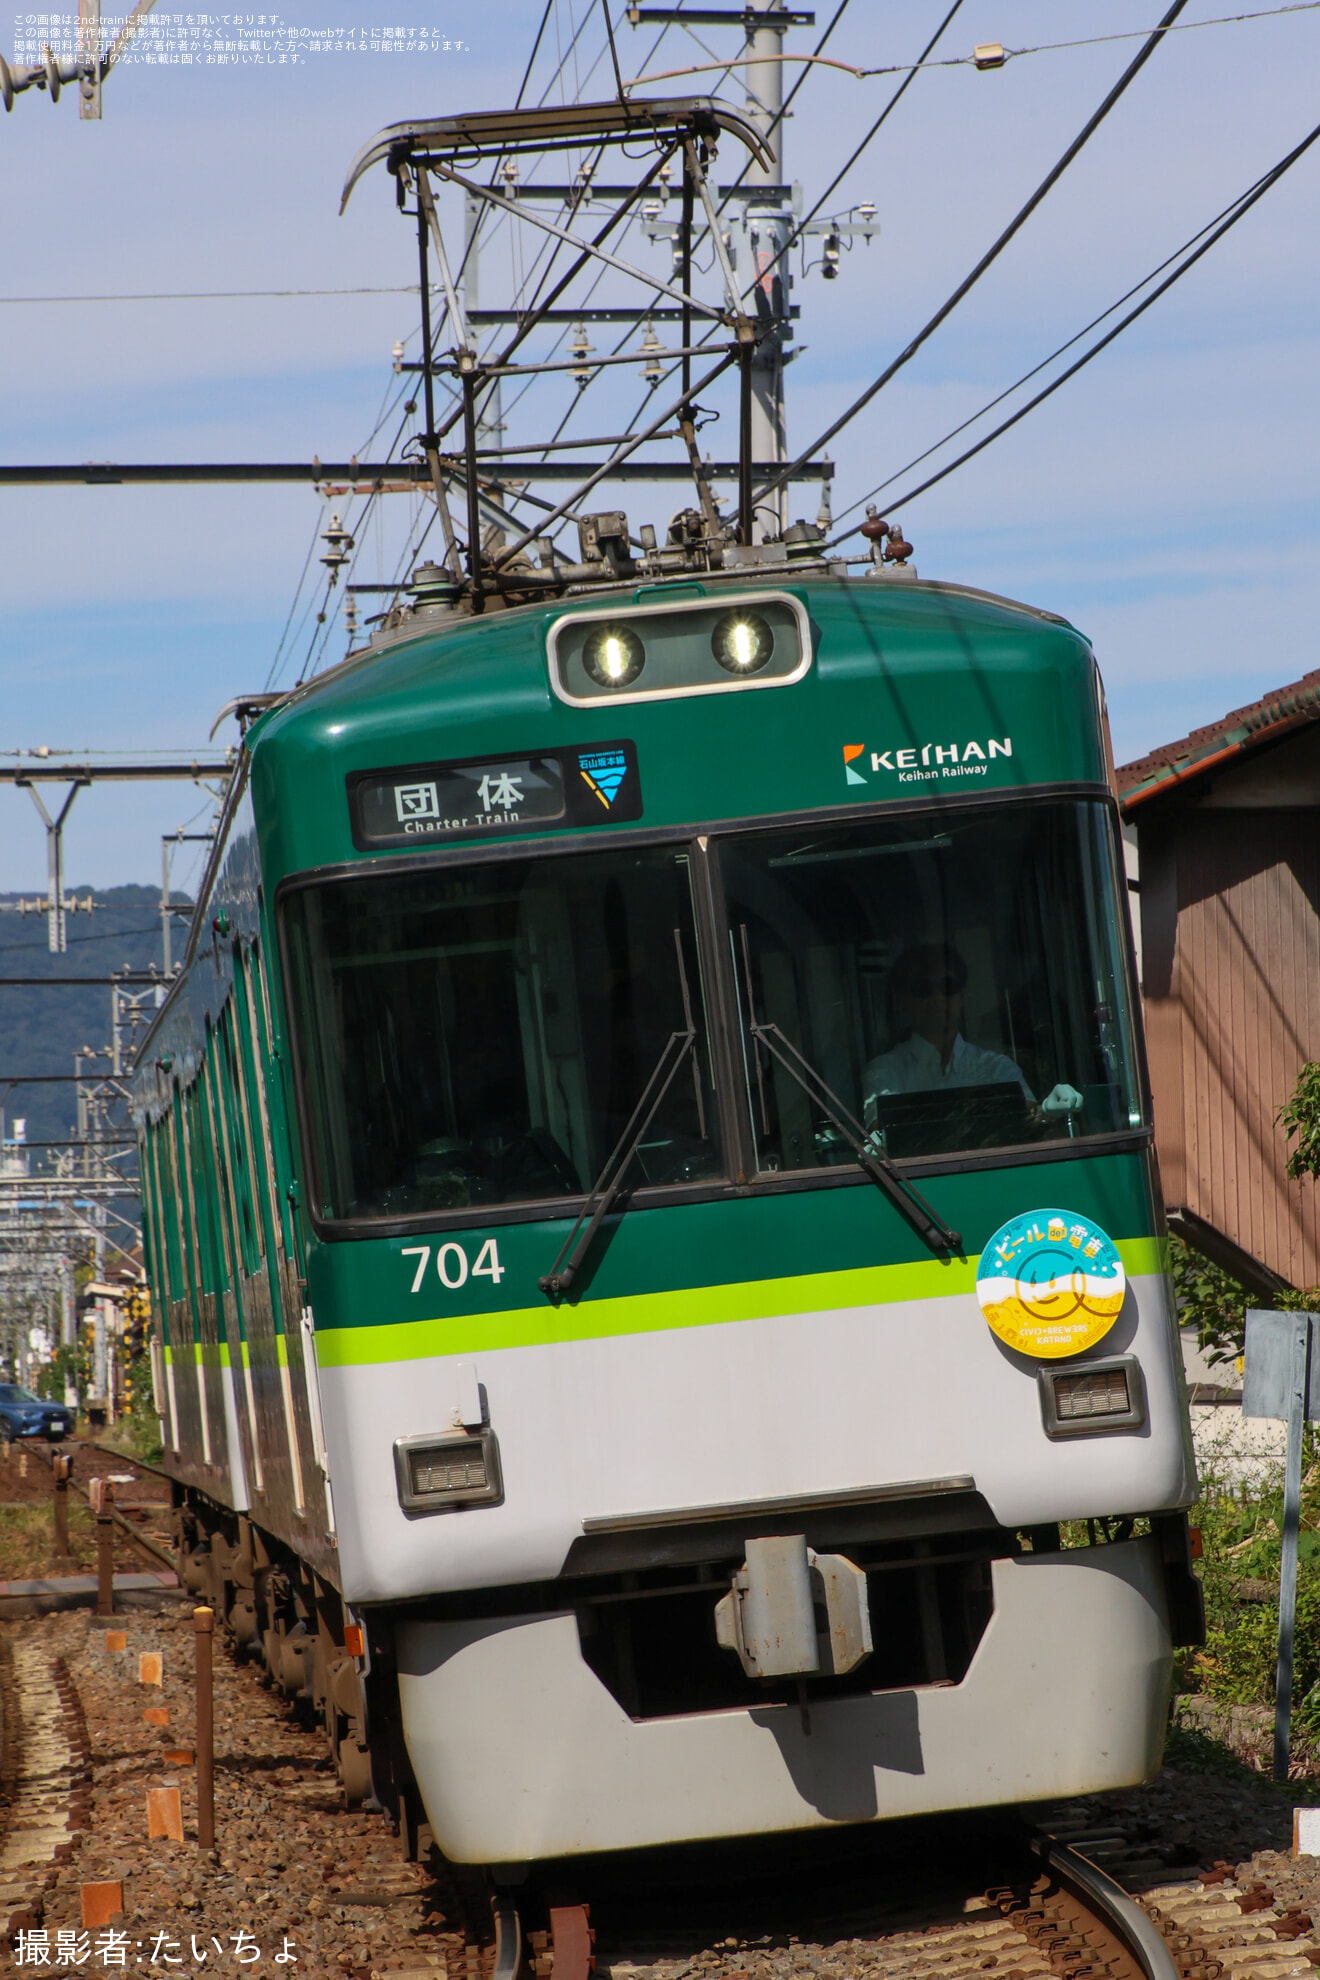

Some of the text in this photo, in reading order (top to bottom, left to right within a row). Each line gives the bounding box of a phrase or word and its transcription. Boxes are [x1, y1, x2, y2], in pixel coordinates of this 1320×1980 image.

[578, 755, 625, 770] 石山坂本線
[870, 737, 1013, 772] KEIHAN
[898, 764, 988, 783] Keihan Railway
[394, 772, 525, 822] 団体
[404, 811, 520, 834] Charter Train
[401, 1238, 506, 1293] 704
